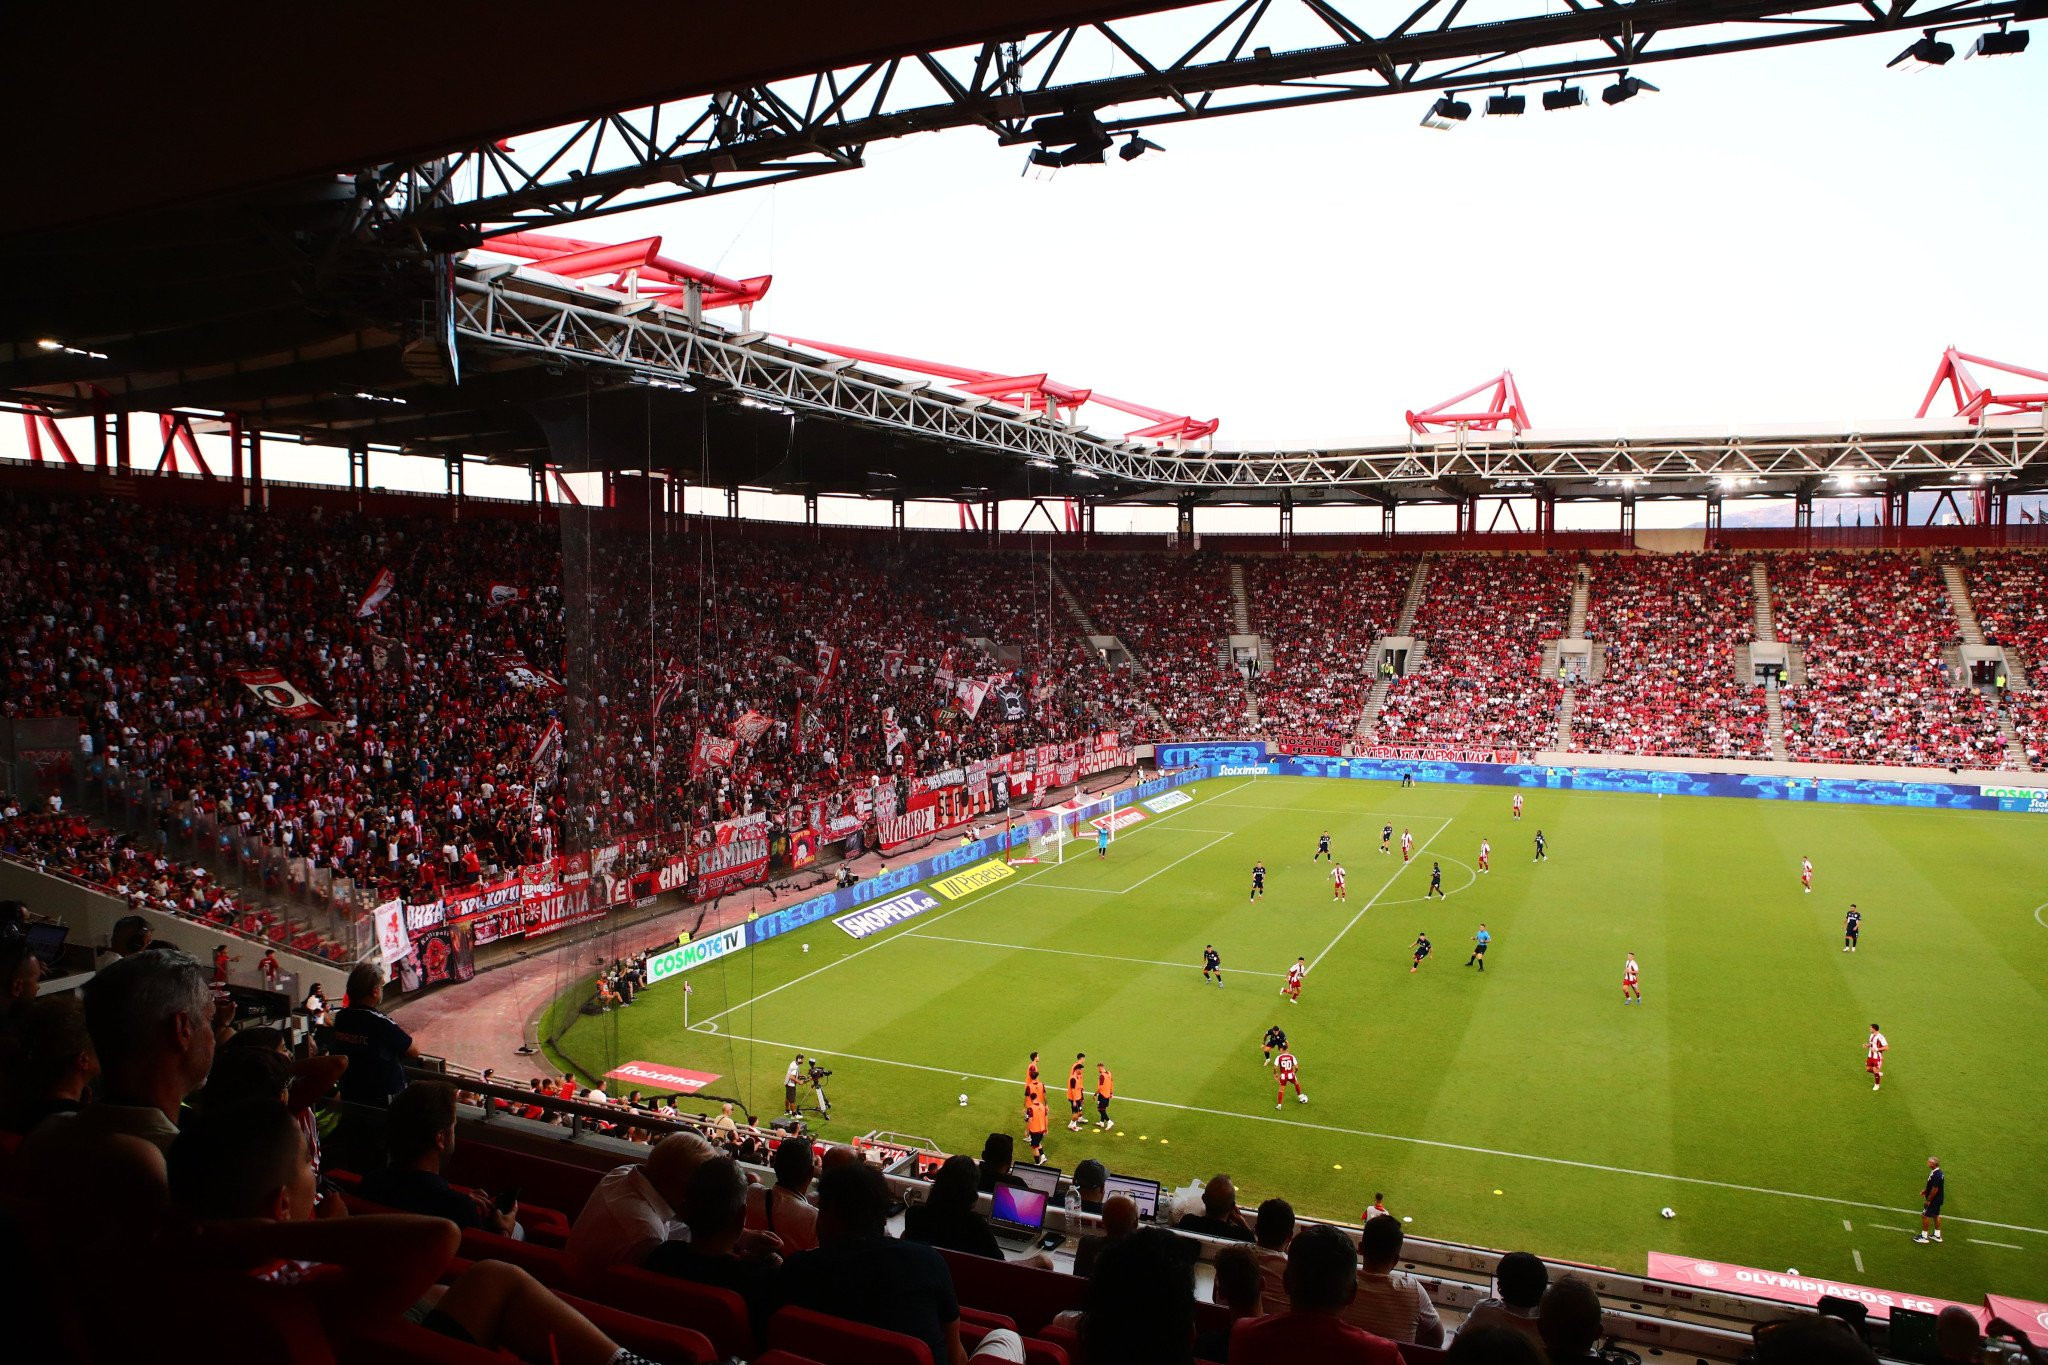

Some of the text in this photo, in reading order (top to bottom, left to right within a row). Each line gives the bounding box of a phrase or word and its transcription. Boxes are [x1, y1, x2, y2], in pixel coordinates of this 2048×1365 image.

[1400, 749, 1420, 760] ΣΤΑ
[1423, 750, 1464, 762] ΑΔΕΡΦΙΑ
[1219, 764, 1268, 776] Stoiximan
[957, 864, 1010, 891] Piraeus
[843, 894, 938, 937] SHOPFLIX.GR
[653, 930, 738, 976] COSMOTE TV
[615, 1065, 708, 1088] Stoiximan
[1281, 1060, 1292, 1069] 90
[1735, 1270, 1935, 1314] OLYMPIACOS FC
